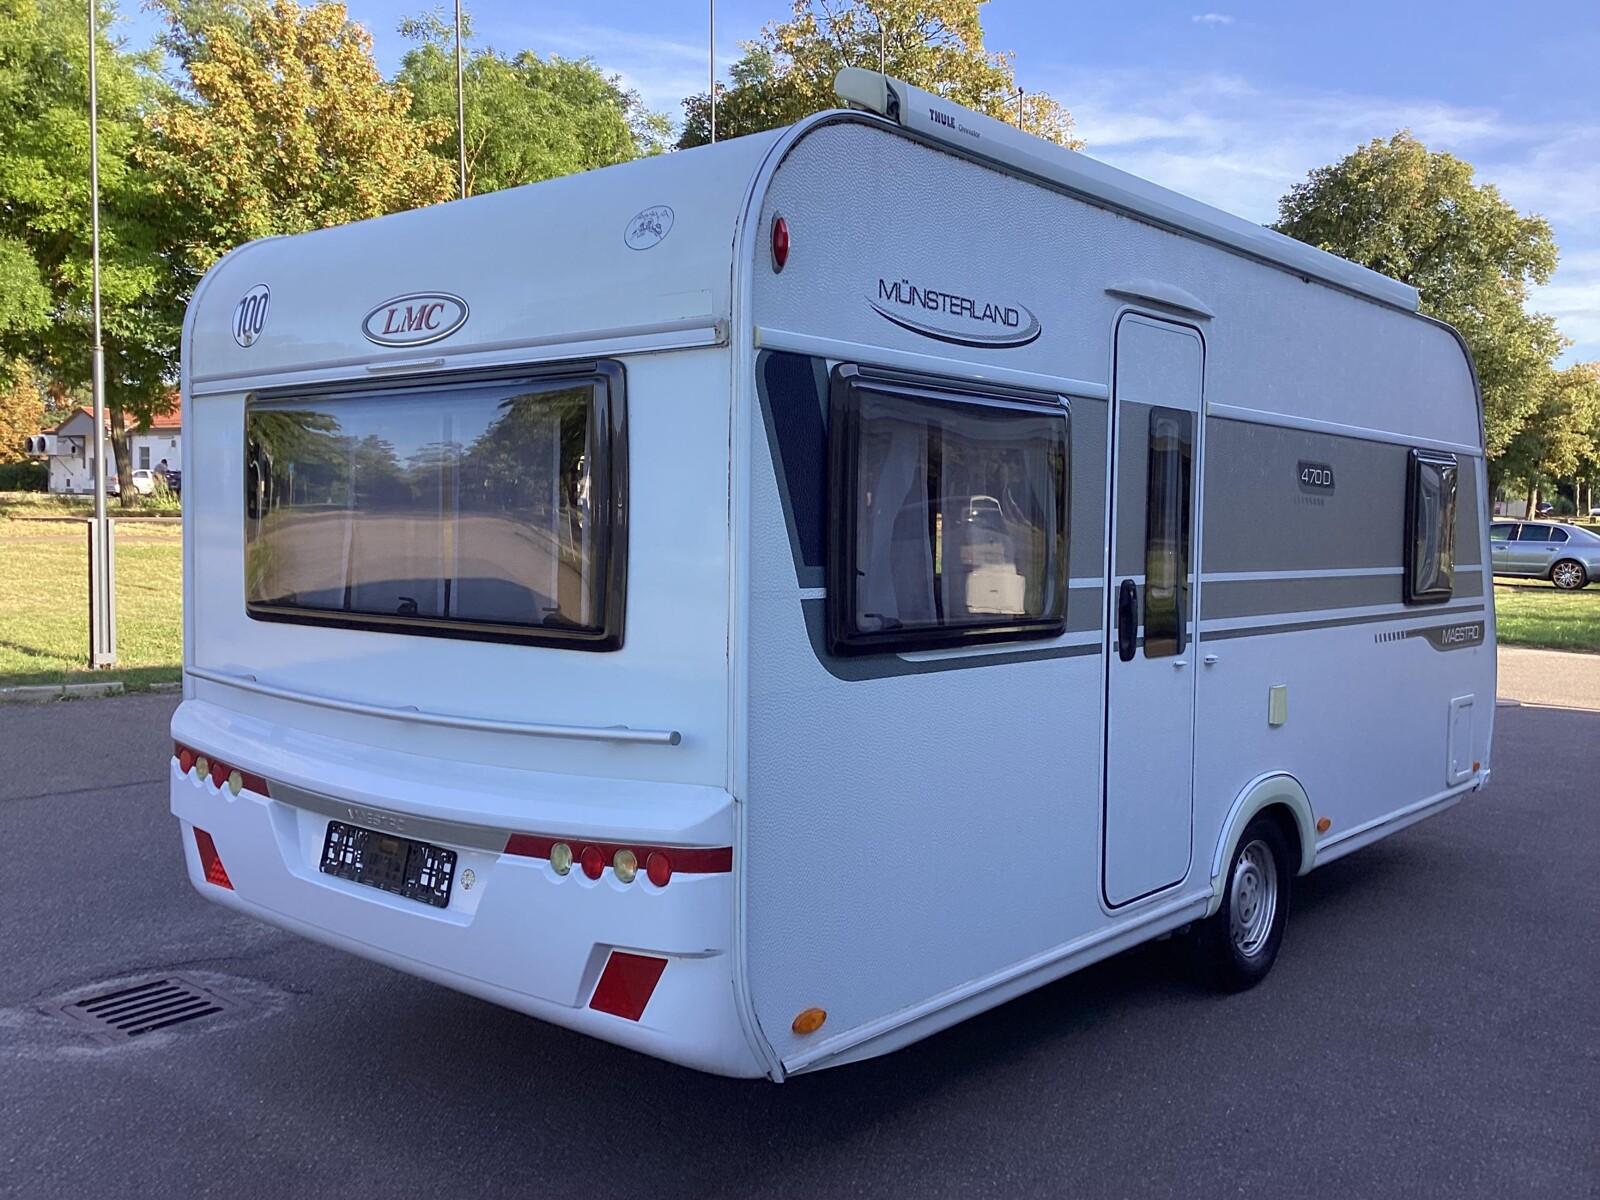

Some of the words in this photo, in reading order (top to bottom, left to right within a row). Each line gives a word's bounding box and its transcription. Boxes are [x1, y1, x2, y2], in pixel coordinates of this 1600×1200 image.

[929, 108, 956, 129] THULE
[237, 292, 268, 338] 100
[382, 302, 445, 335] LMC
[878, 278, 1019, 327] MÜNSTERLAND
